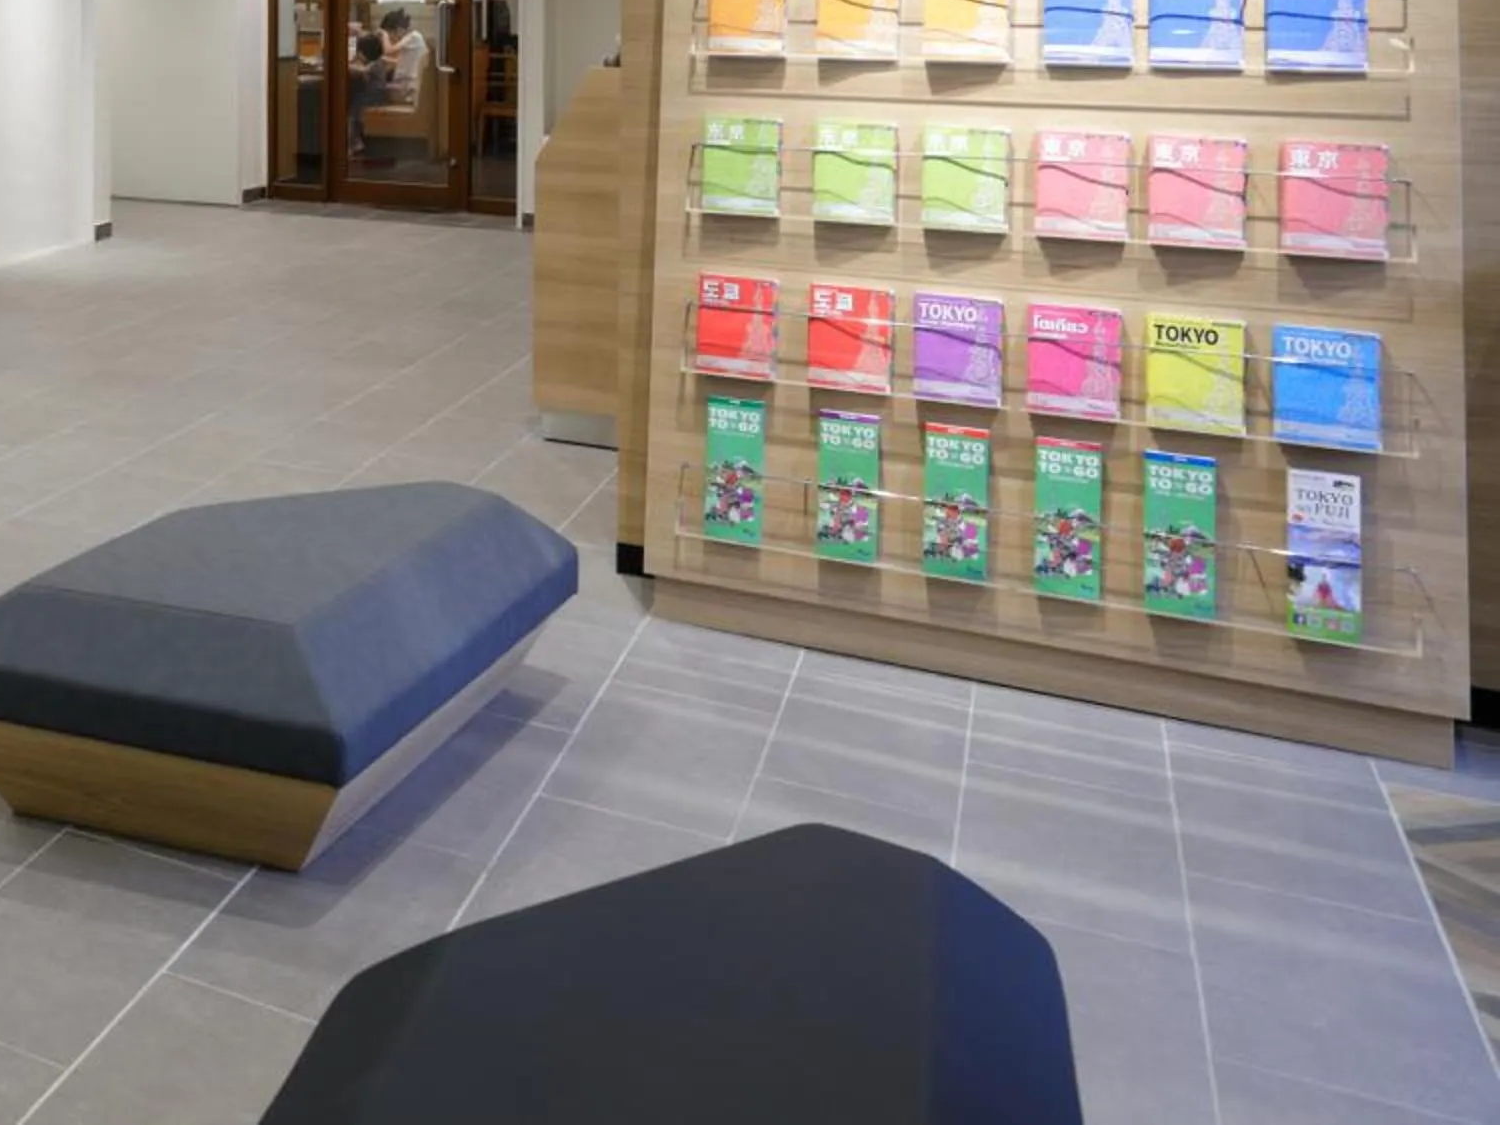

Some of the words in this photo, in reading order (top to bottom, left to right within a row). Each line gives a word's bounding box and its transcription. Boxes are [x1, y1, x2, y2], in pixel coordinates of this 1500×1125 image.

[1288, 147, 1341, 170] 東京
[918, 302, 977, 322] TOKYO
[1153, 323, 1219, 346] TOKYO
[1283, 336, 1351, 359] TOKYO
[708, 407, 760, 423] TOKYO
[821, 421, 875, 439] TOKYO
[927, 436, 985, 453] TOKYO
[1037, 449, 1099, 466] TOKYO
[1149, 464, 1212, 482] TOKYO
[1295, 487, 1354, 506] TOKYO
